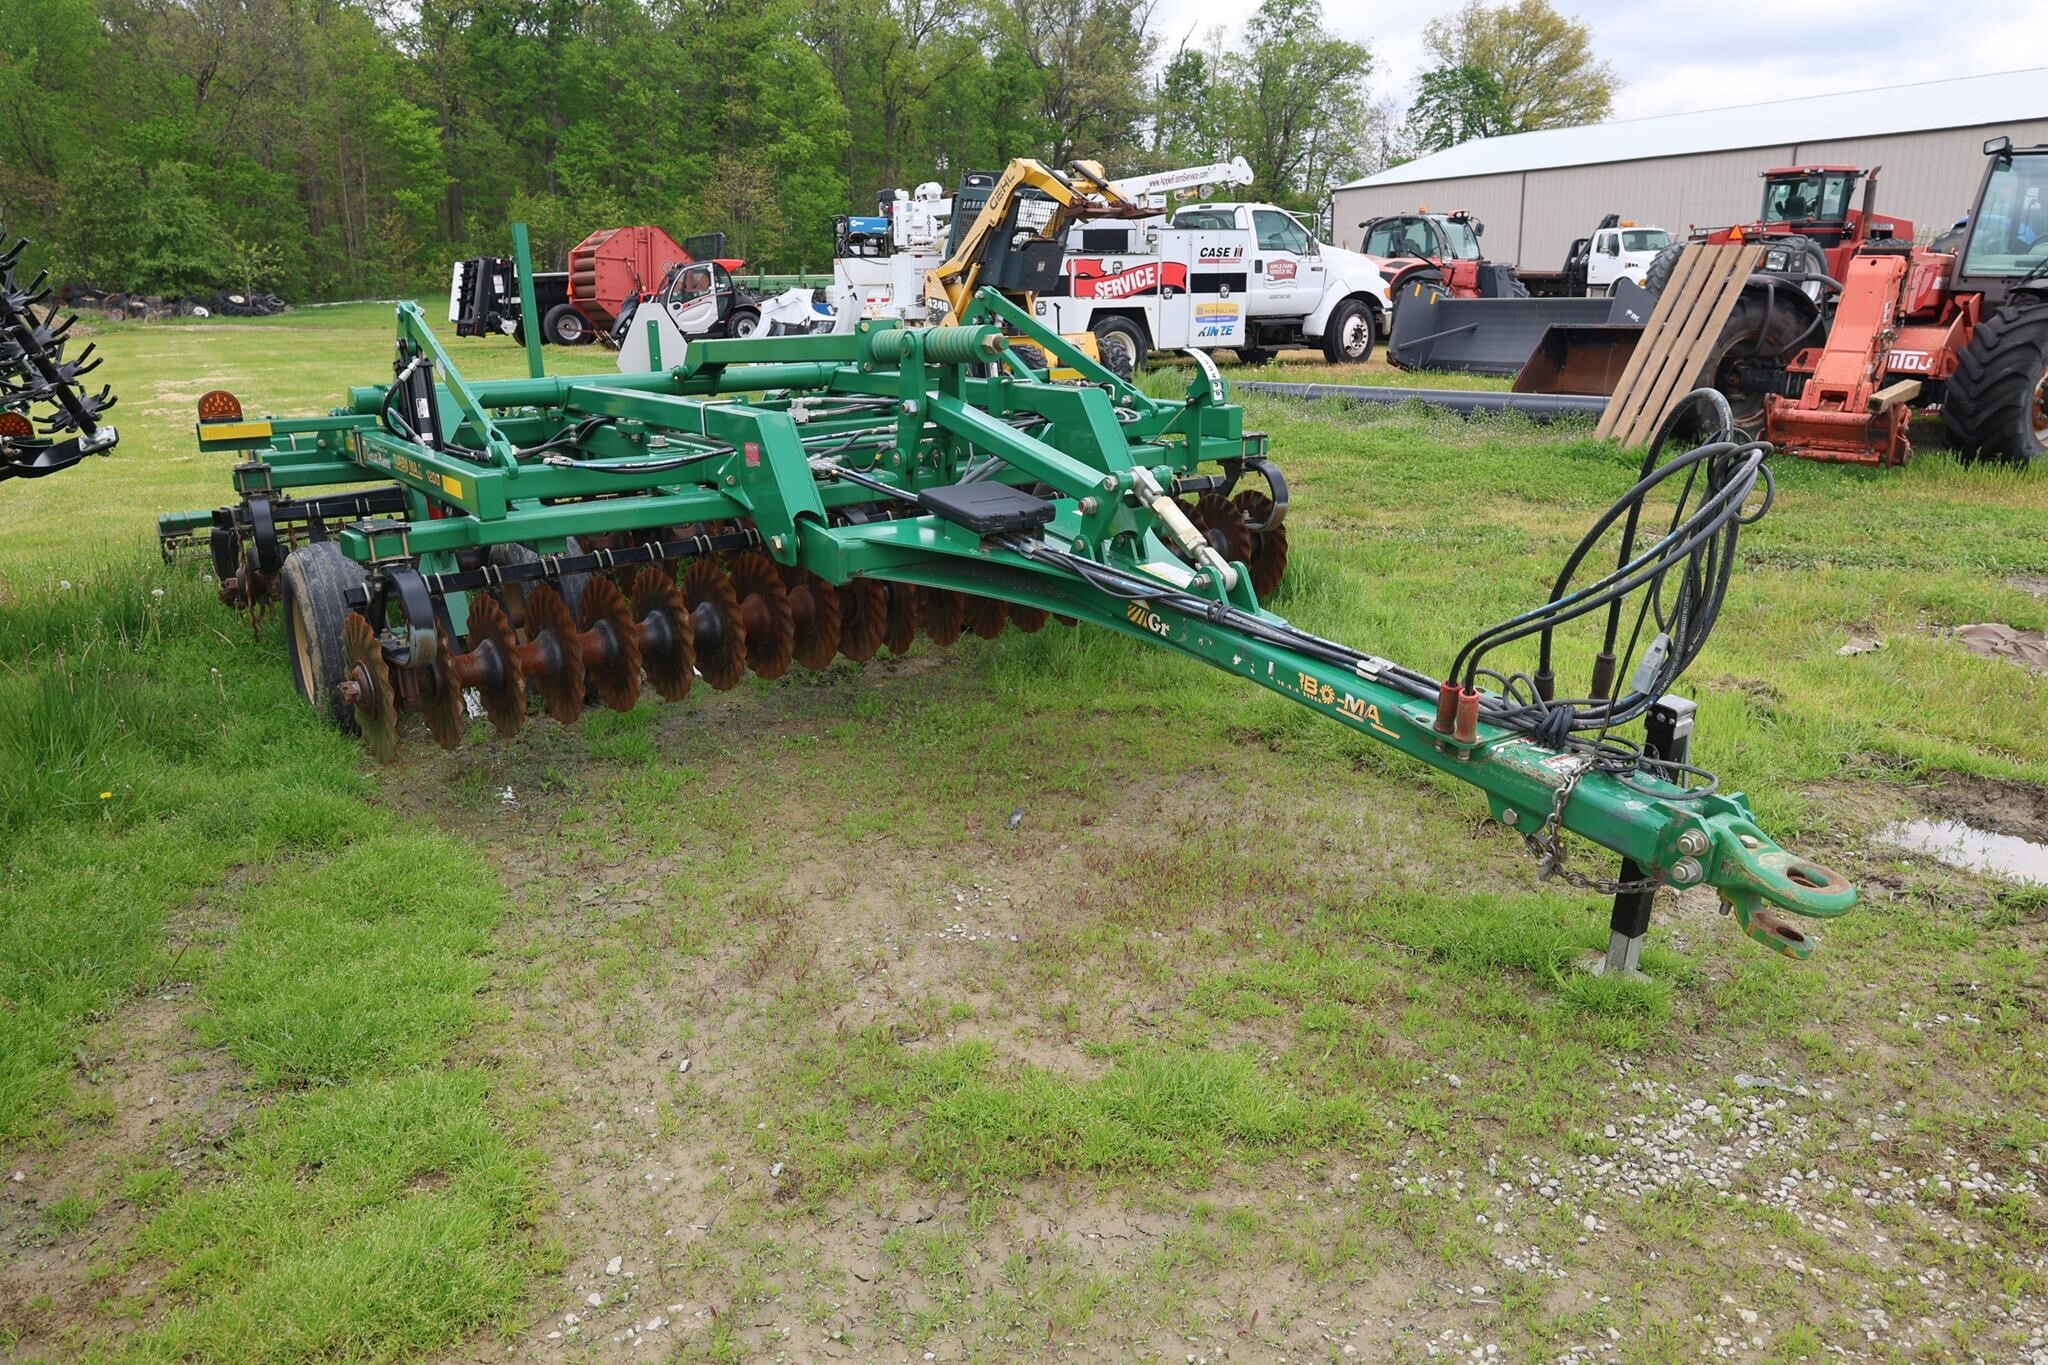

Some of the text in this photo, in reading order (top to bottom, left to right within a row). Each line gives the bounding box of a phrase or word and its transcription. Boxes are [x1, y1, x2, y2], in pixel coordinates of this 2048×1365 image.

[989, 175, 1016, 210] GEHL
[1200, 247, 1231, 258] CASE
[1094, 266, 1156, 298] SERVICE
[1197, 325, 1235, 337] KINZE
